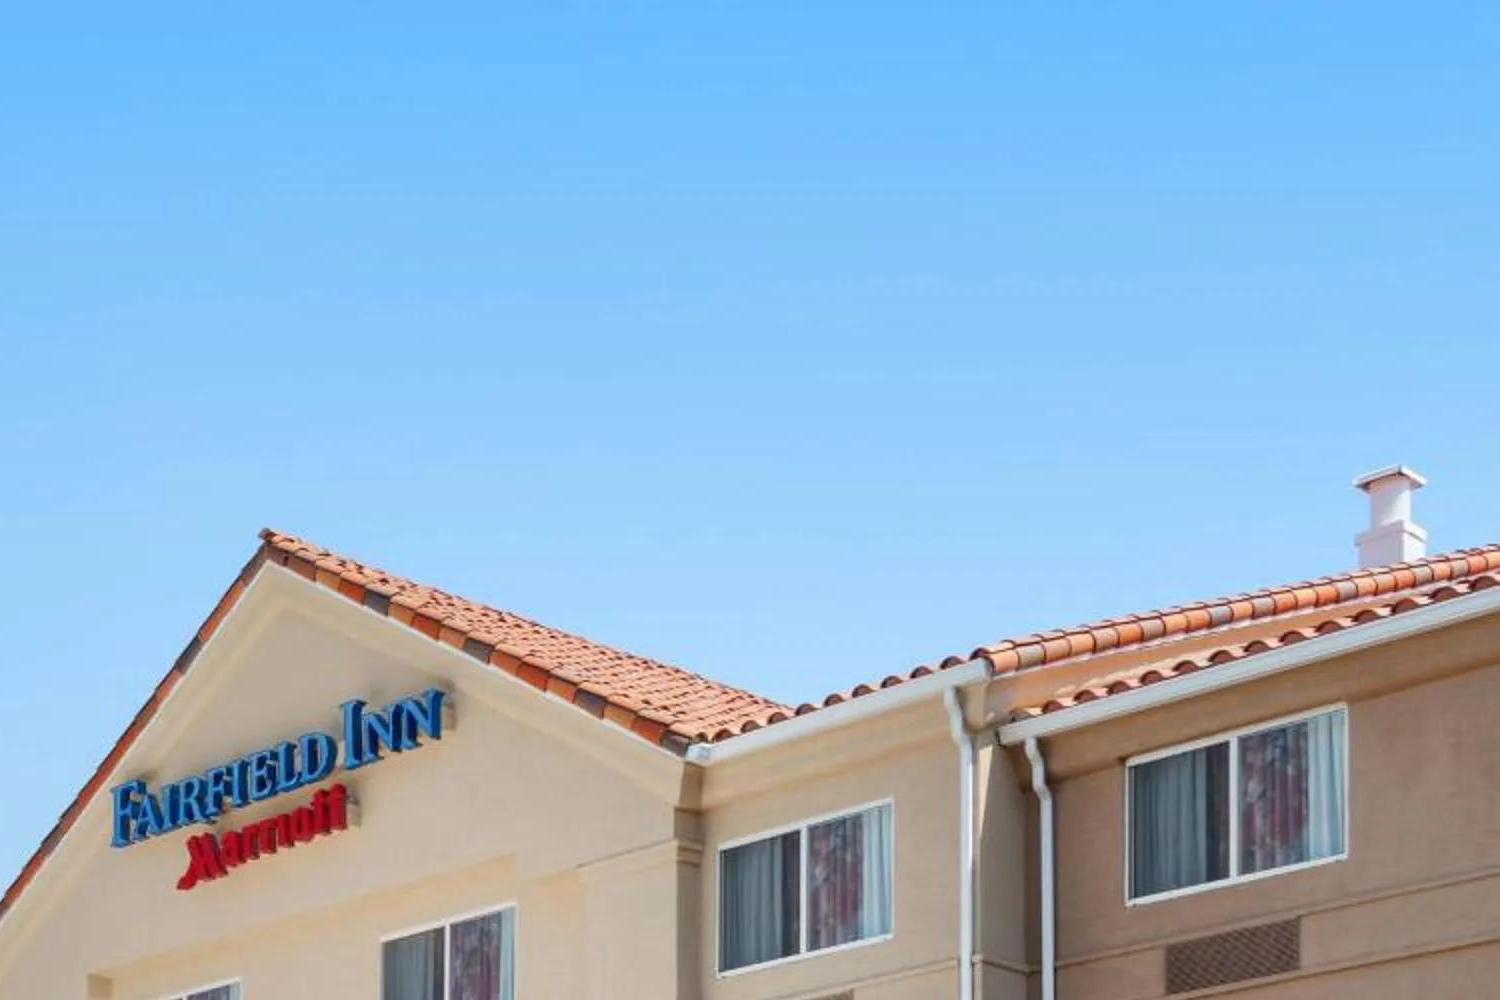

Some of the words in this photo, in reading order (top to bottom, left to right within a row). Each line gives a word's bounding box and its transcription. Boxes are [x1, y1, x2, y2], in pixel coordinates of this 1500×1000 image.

[111, 732, 338, 848] FAIRFIELD
[341, 688, 445, 770] INN
[176, 783, 349, 890] Marriott
